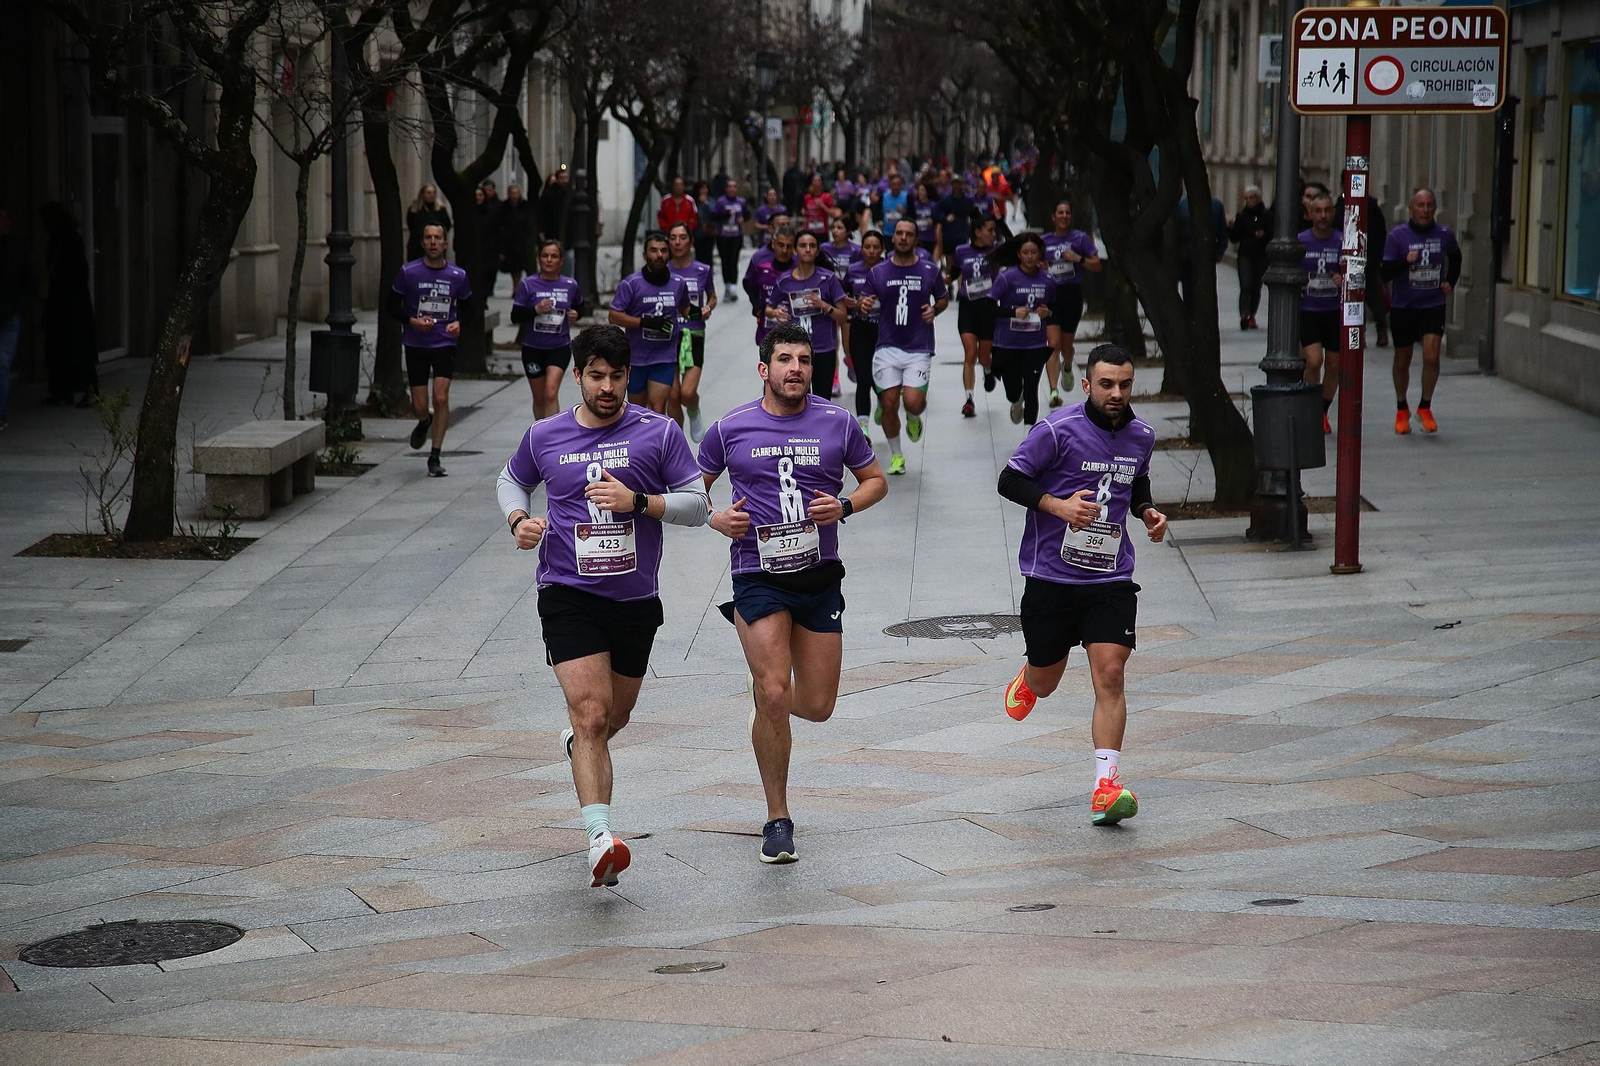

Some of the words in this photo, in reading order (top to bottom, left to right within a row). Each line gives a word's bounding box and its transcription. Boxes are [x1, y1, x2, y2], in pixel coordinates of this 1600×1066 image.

[1300, 17, 1379, 41] ZONA
[1392, 16, 1499, 40] PEONIL
[1410, 57, 1494, 73] CIRCULACIÓN
[560, 452, 590, 465] CARREIRA
[592, 452, 602, 461] DA
[604, 448, 628, 459] MULLER
[752, 446, 782, 458] CARREIRA
[784, 446, 793, 456] DA
[794, 446, 820, 456] MULLER
[602, 457, 630, 469] OURENSE
[794, 456, 820, 466] OURENSE
[1082, 461, 1108, 472] CARREIRA
[1109, 464, 1116, 472] DA
[598, 539, 620, 550] 423
[779, 538, 799, 548] 377
[1086, 536, 1104, 546] 364
